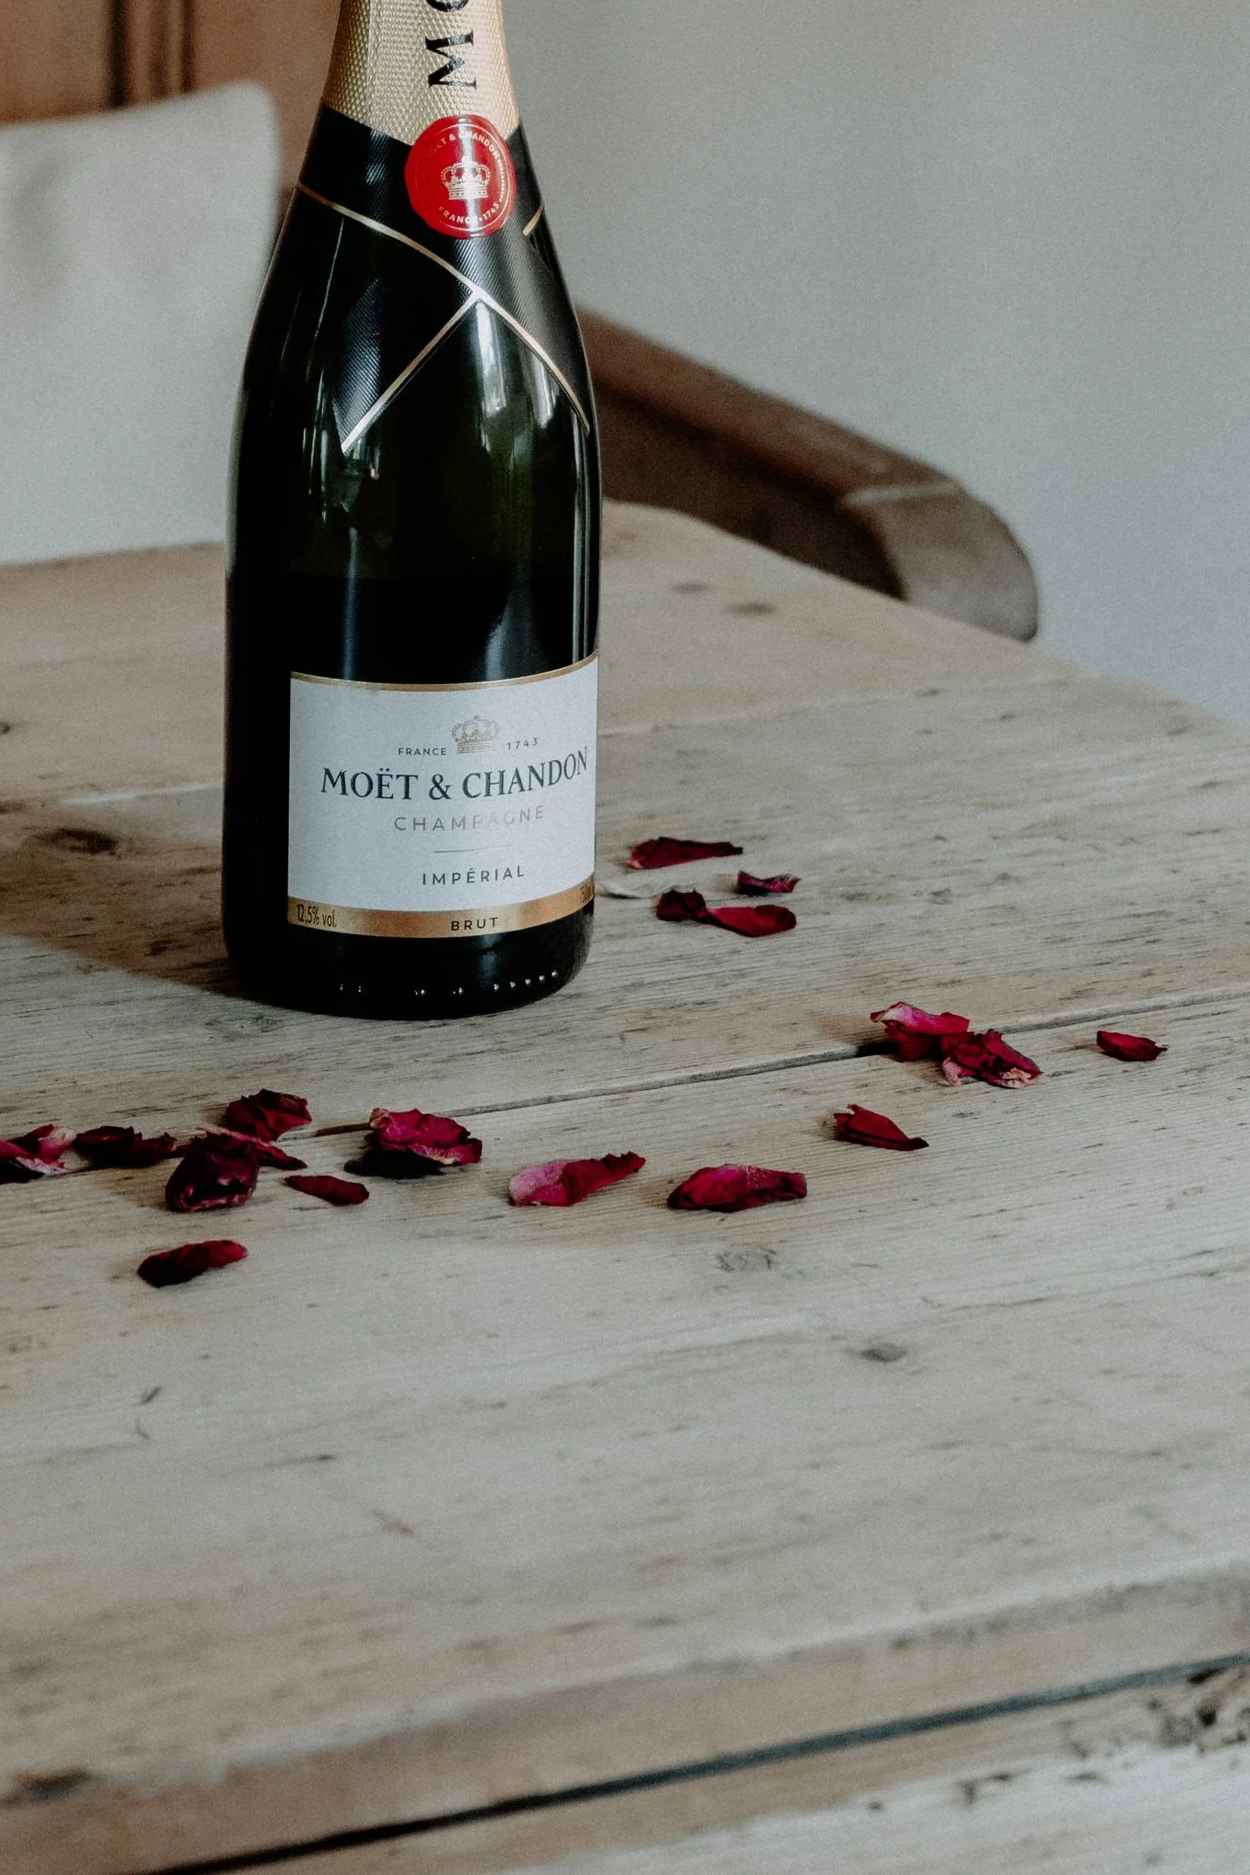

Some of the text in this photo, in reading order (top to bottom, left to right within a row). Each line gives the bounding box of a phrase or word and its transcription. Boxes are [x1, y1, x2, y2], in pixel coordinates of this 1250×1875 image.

[438, 206, 478, 226] FRANC
[398, 737, 538, 757] FRANCE 1743
[321, 746, 588, 801] MOËT & CHANDON
[394, 805, 544, 832] CHAMPAGNE
[422, 865, 525, 885] IMPÉRIAL
[451, 917, 498, 931] BRUT
